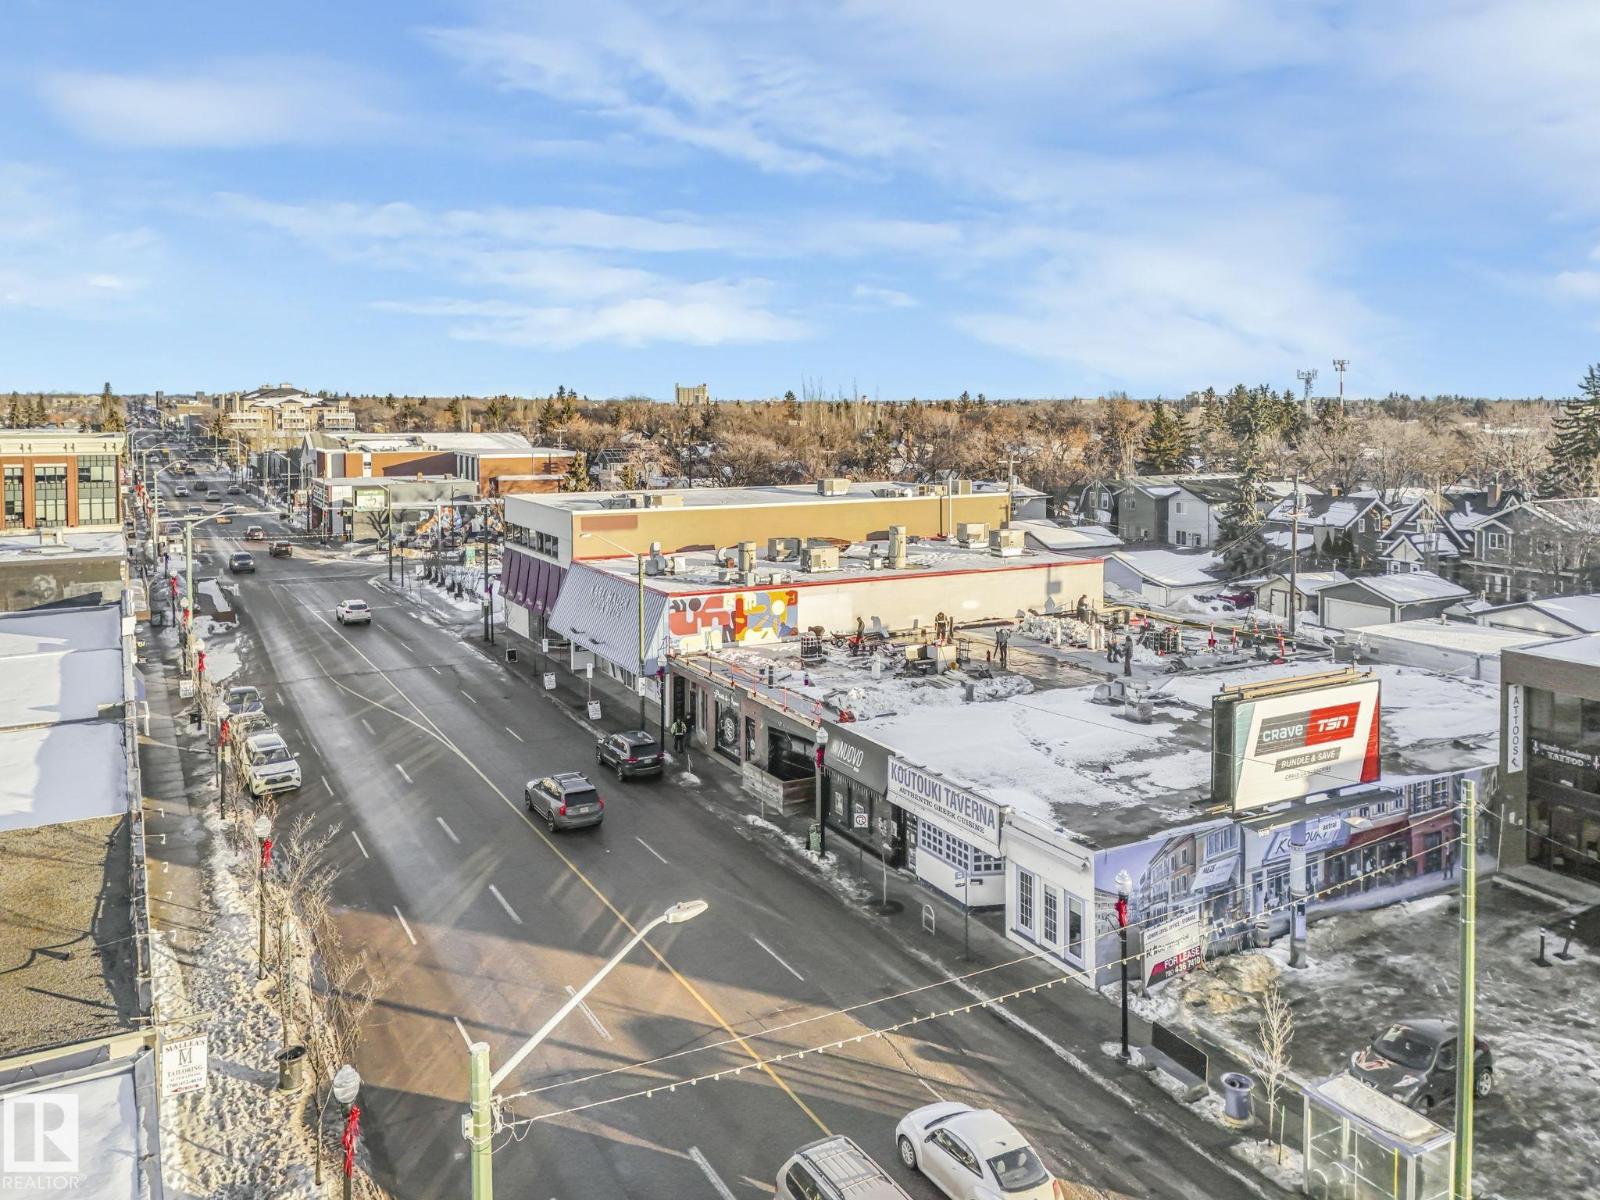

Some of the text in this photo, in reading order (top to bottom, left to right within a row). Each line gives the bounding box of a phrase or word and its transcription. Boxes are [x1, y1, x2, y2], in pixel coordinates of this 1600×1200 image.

[1317, 716, 1349, 732] TSN
[1512, 685, 1520, 756] TATTOOS
[838, 741, 864, 768] NUOVO
[1281, 755, 1311, 769] BUNDLE
[1318, 750, 1336, 762] SAVE
[1547, 751, 1584, 767] TATTOO
[891, 762, 942, 803] KOUTOUKI
[944, 787, 996, 830] TAVERNA
[899, 786, 985, 834] AUTHENTIC GREEK CUISINE
[1322, 821, 1337, 831] astral
[1164, 946, 1200, 969] FOR LEASE
[1174, 964, 1187, 974] 436
[178, 1048, 192, 1066] M
